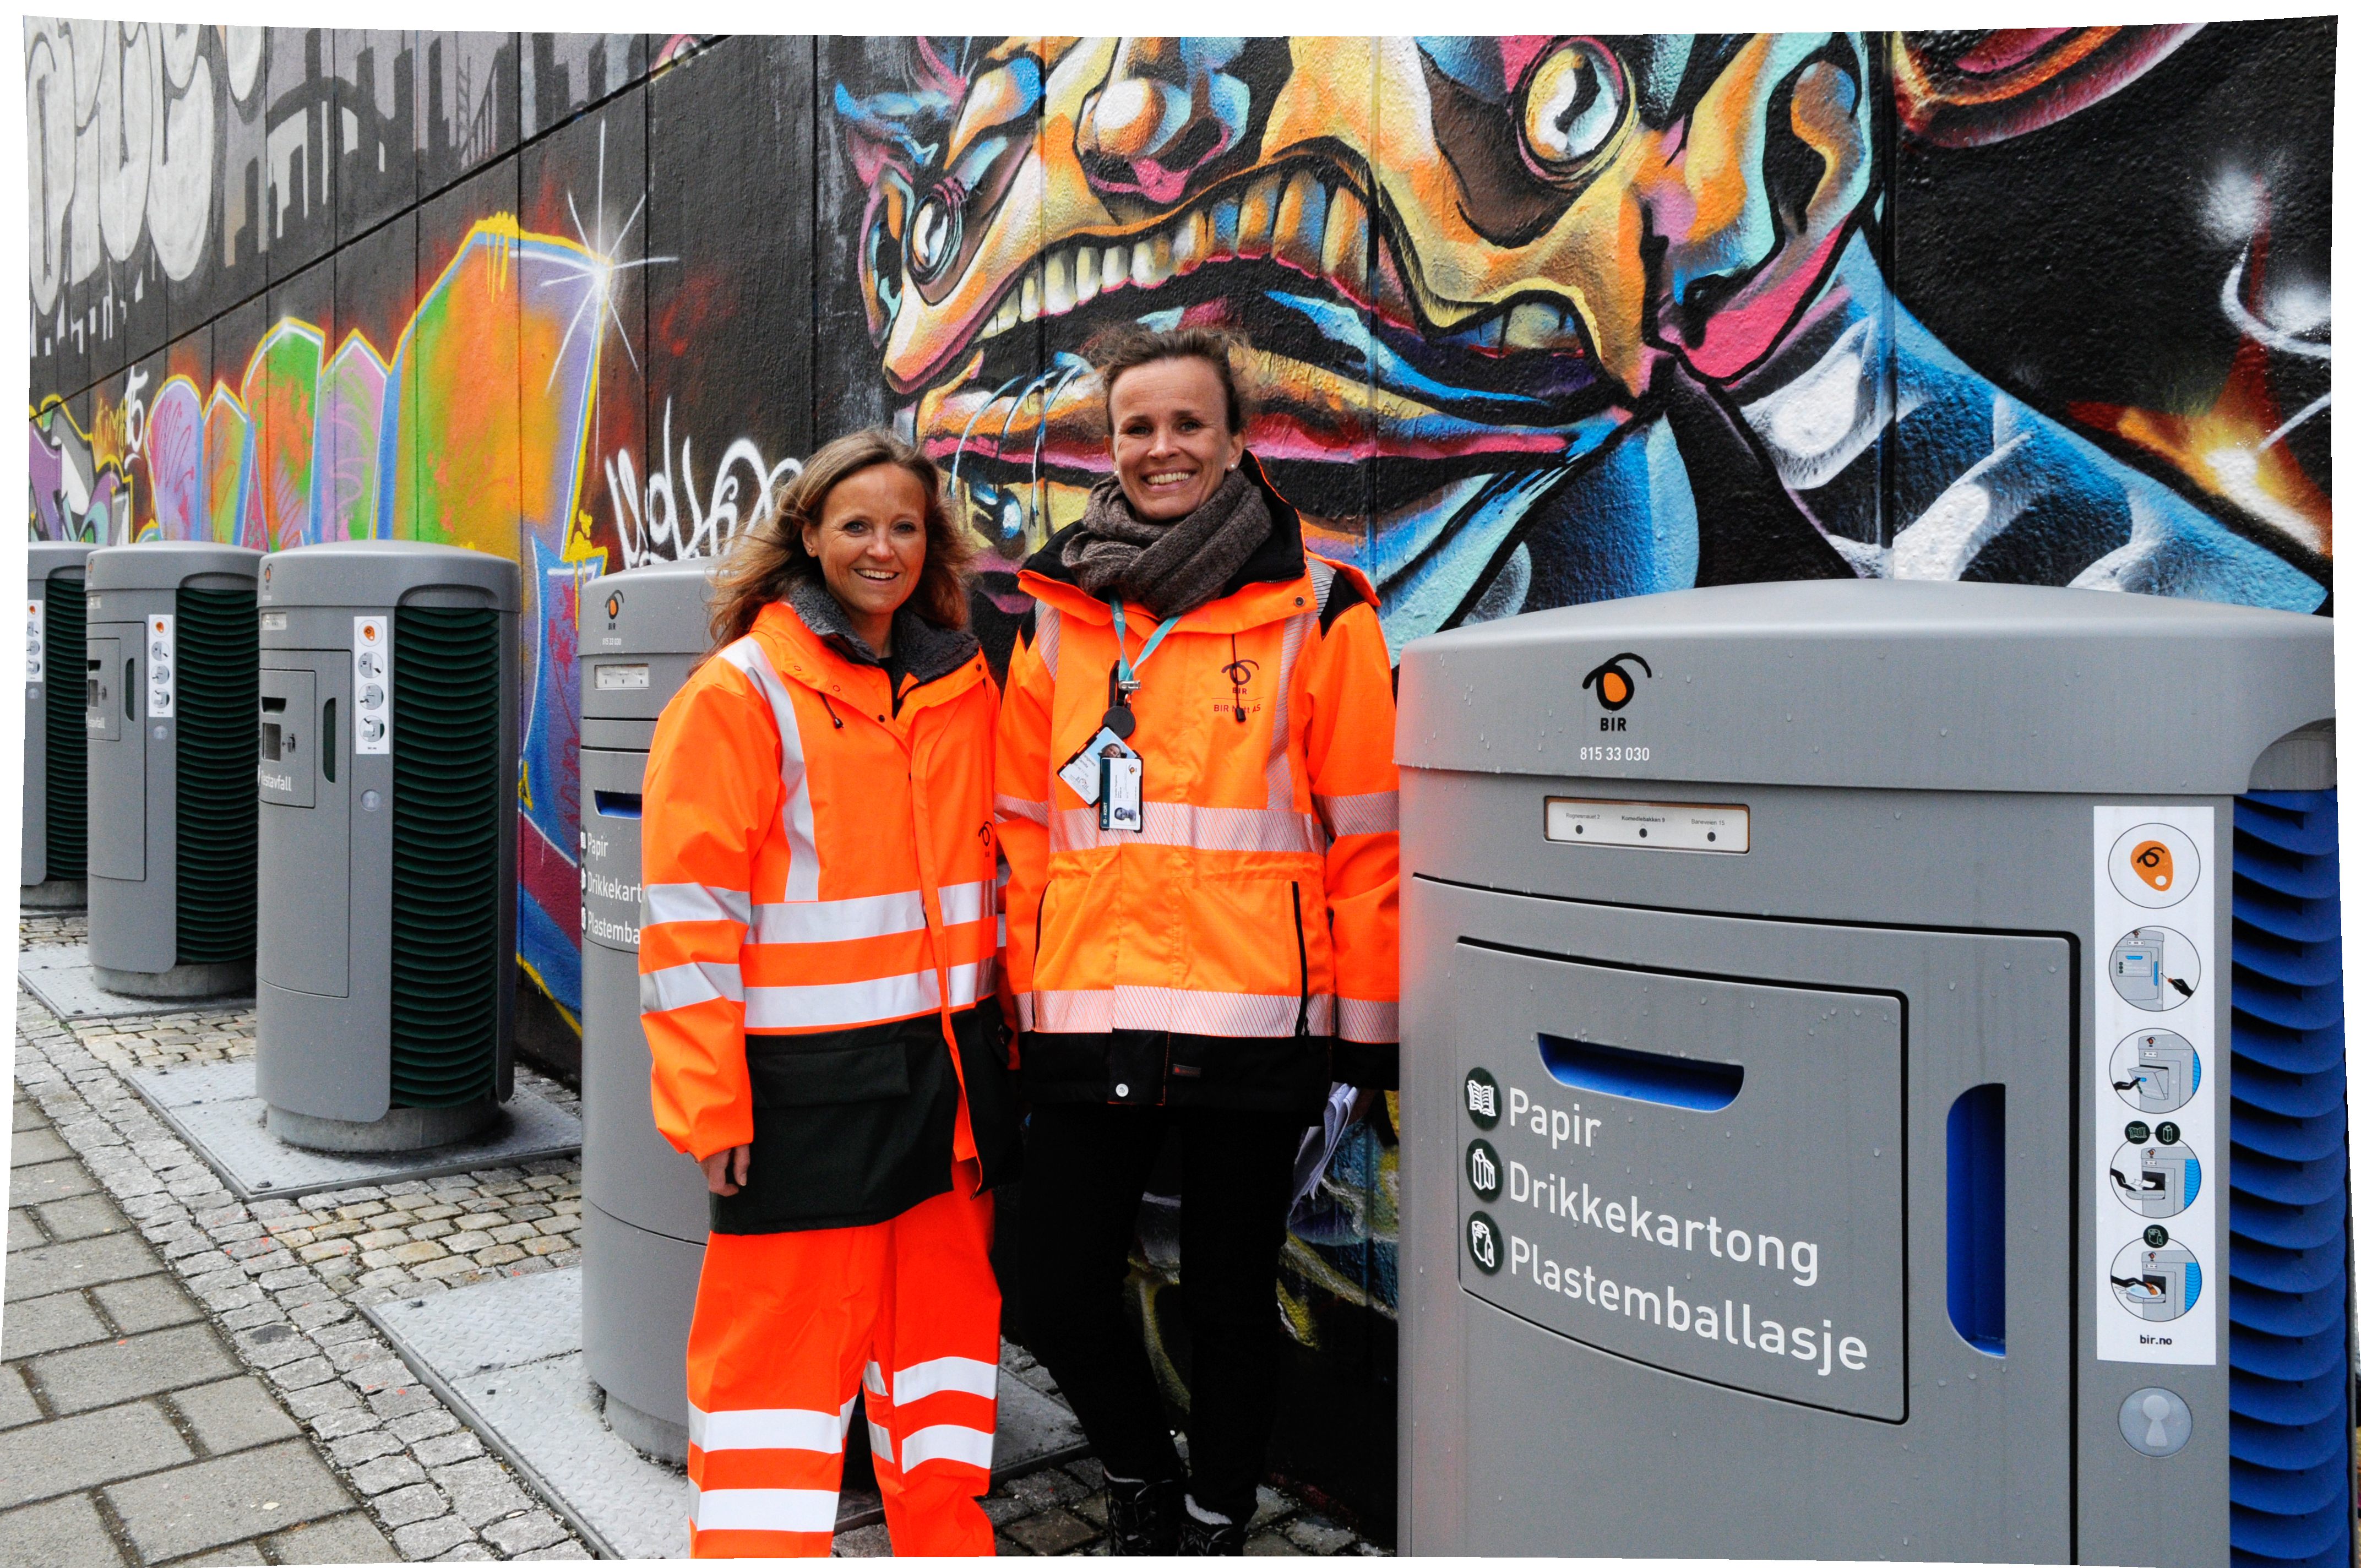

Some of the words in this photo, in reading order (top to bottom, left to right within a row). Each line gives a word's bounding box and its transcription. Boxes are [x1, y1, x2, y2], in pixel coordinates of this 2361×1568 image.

[1214, 704, 1229, 712] BIR
[1232, 705, 1250, 714] Ntt
[1252, 704, 1261, 714] AS
[1600, 717, 1626, 731] BIR
[1580, 747, 1602, 760] 815
[1606, 747, 1622, 761] 33
[1625, 747, 1650, 761] 030
[587, 832, 608, 861] Papir
[1510, 1087, 1602, 1150] Papir
[1510, 1161, 1819, 1287] Drikkekartong
[1510, 1235, 1868, 1376] Plastemballasje
[2140, 1335, 2173, 1345] bir.no
